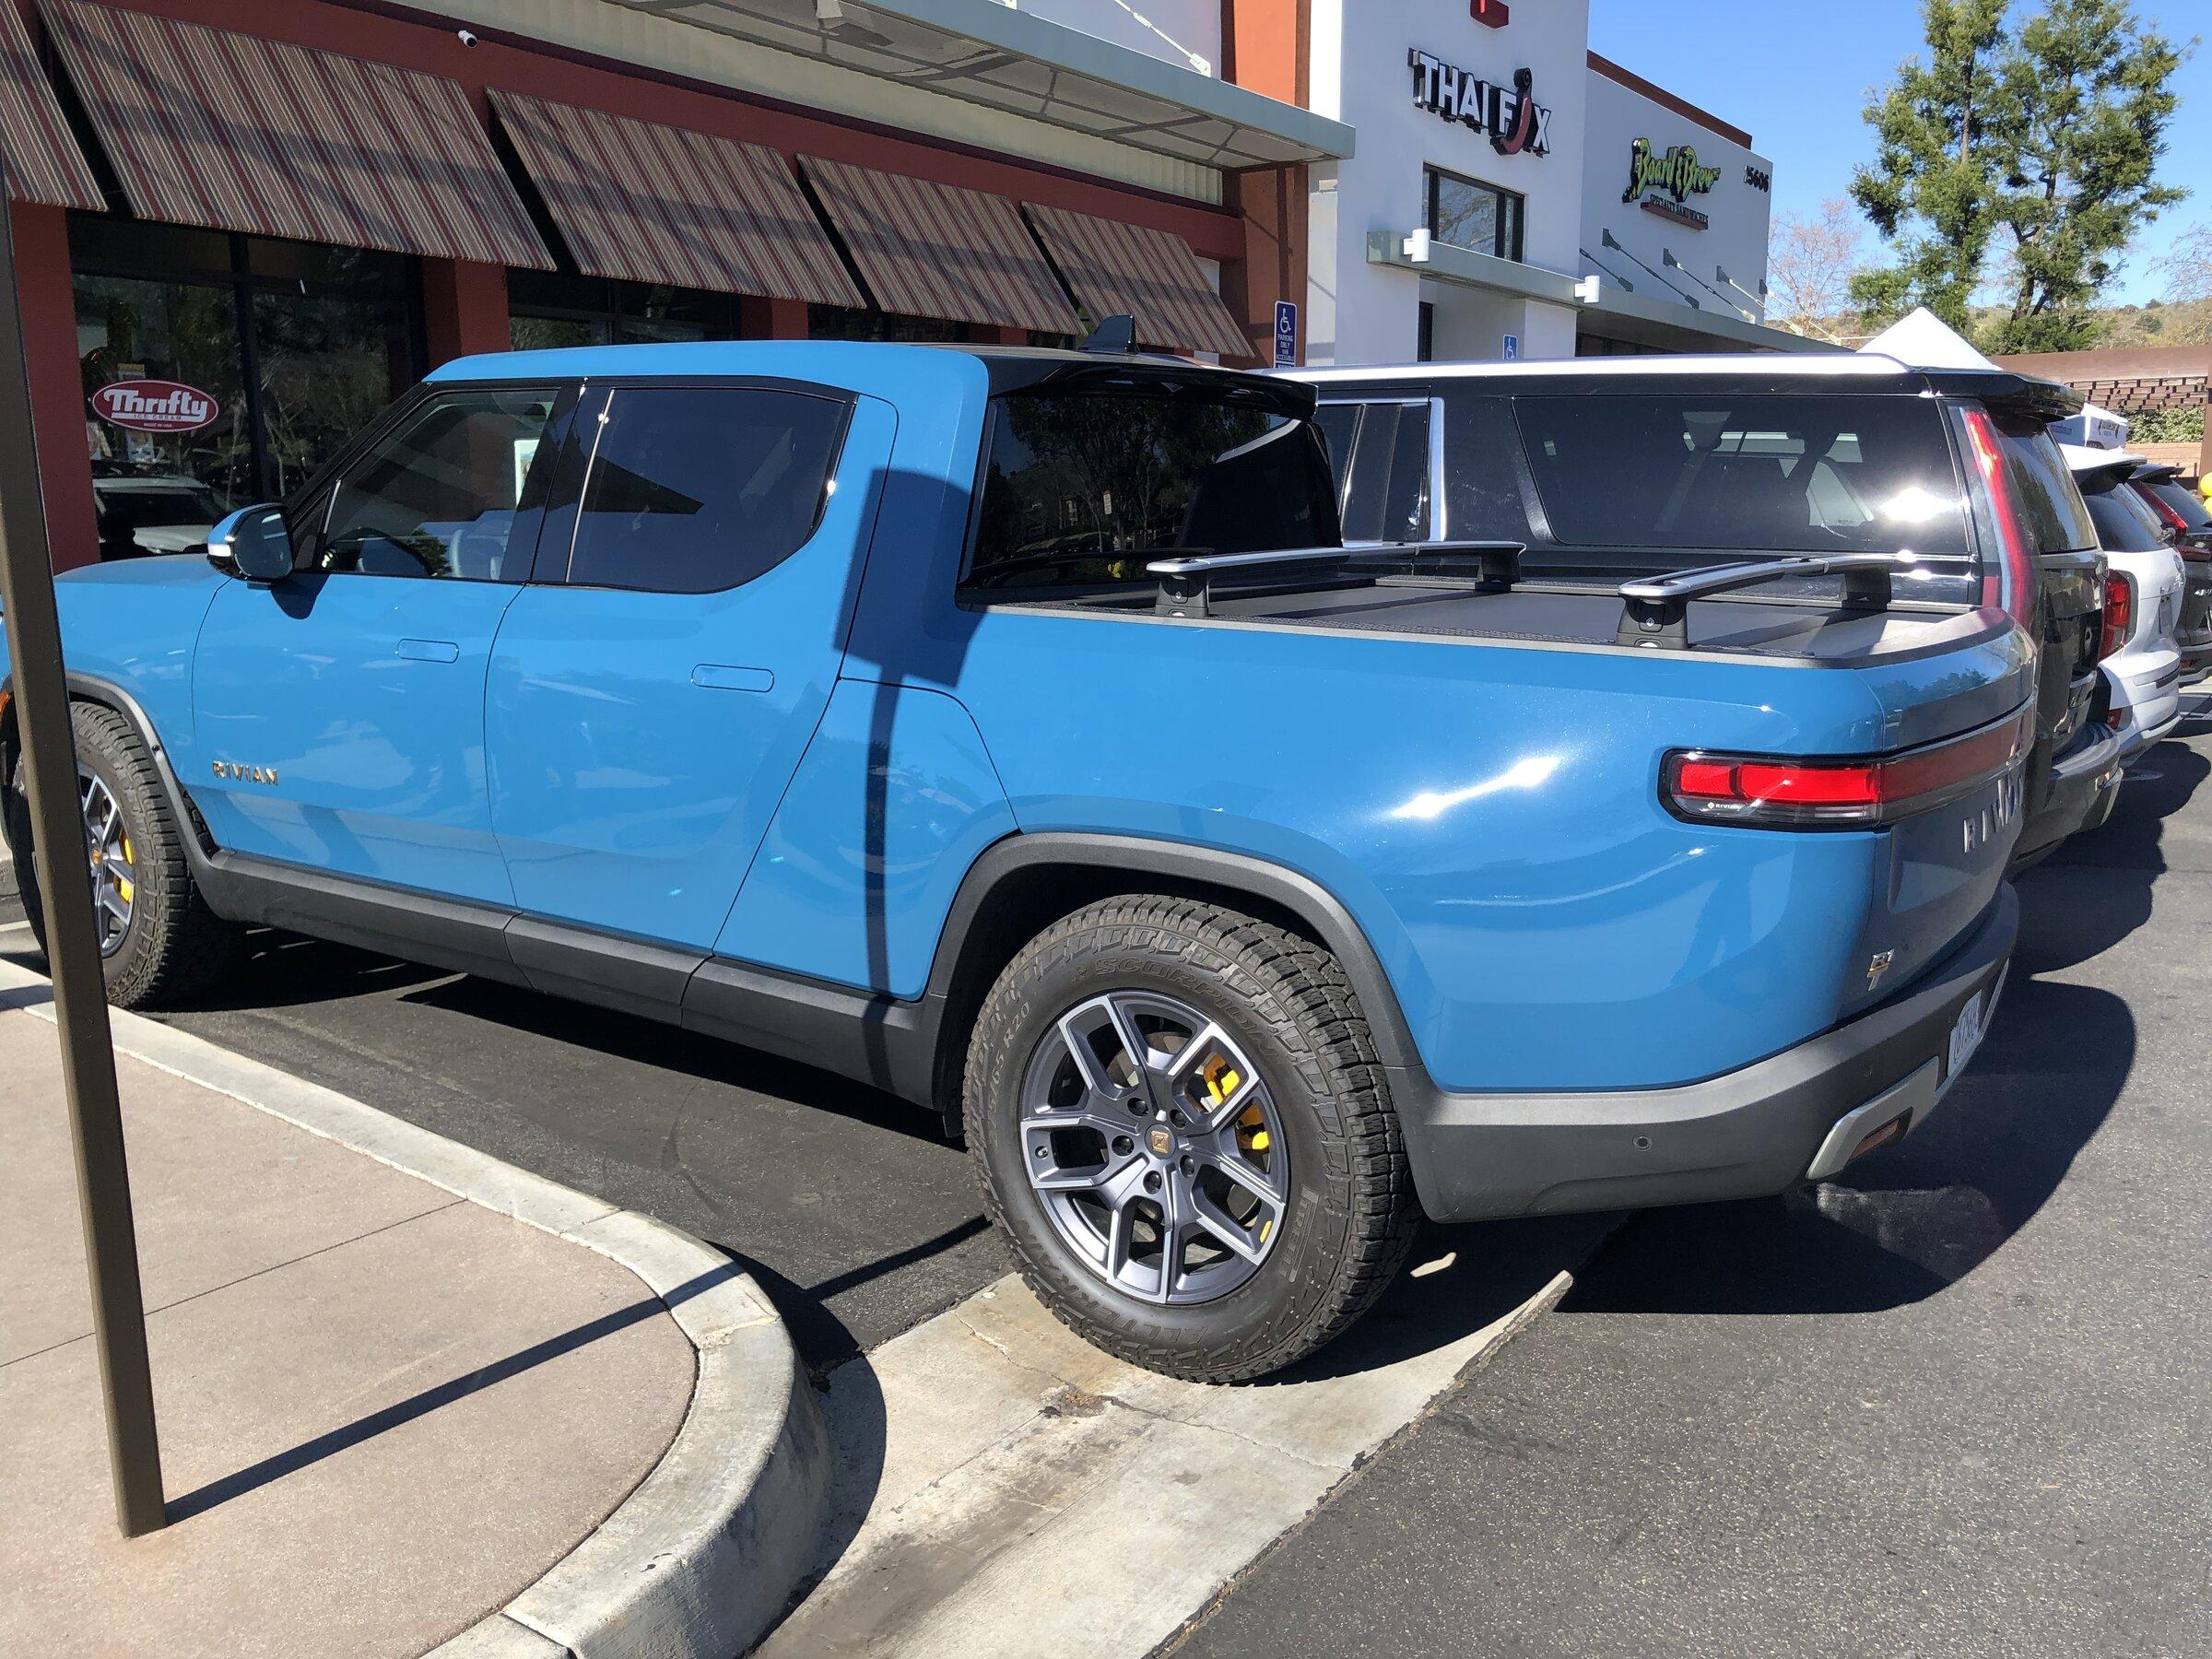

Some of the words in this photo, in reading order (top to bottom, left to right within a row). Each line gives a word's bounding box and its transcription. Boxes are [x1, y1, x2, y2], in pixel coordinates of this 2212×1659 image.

[1409, 48, 1489, 131] THAI
[103, 389, 208, 422] Thrifty
[213, 759, 278, 786] RIVIAN
[1003, 1002, 1030, 1049] R20
